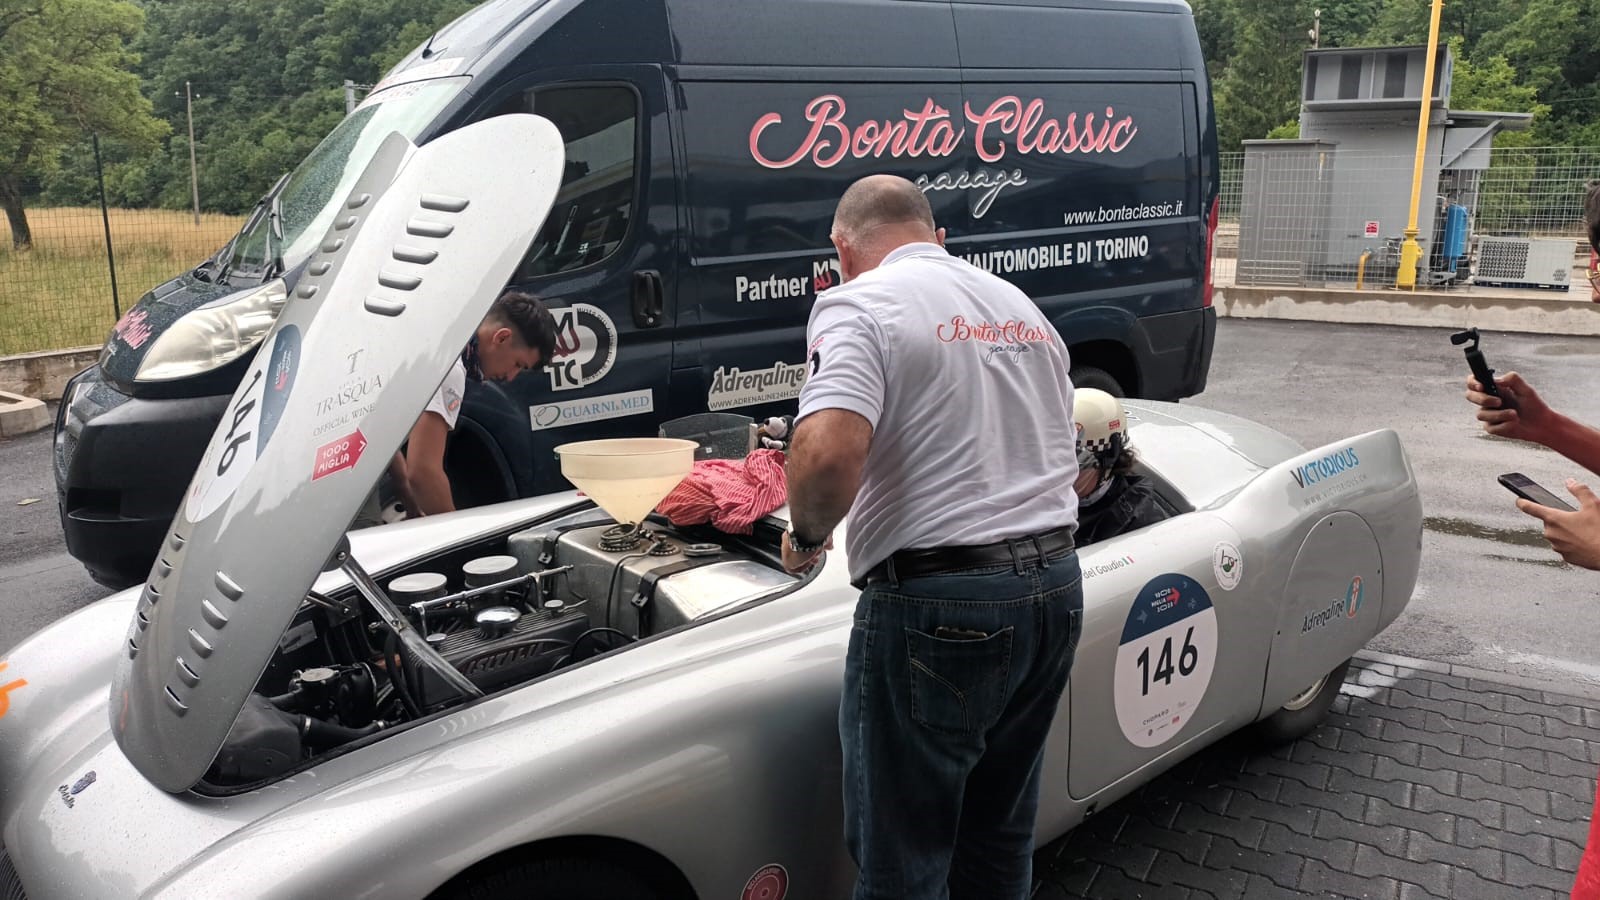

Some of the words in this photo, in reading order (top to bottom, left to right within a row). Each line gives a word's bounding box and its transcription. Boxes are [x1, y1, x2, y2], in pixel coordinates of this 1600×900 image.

[965, 96, 1138, 163] Classic
[1064, 200, 1183, 225] www.bontaclassic.it
[1077, 240, 1091, 264] DI
[1096, 235, 1149, 262] TORINO
[735, 274, 809, 302] Partner
[711, 364, 805, 394] Adrenaline
[315, 374, 382, 417] TRASQUA
[710, 389, 802, 409] WWW.ADRENALINE24H.CO
[216, 369, 262, 477] 146
[313, 415, 351, 437] OFFICIAL
[351, 403, 377, 422] WINE
[318, 453, 350, 474] MIGLIA
[323, 440, 350, 460] 1000
[1290, 447, 1359, 489] VICTORIOUS
[1083, 566, 1096, 579] del
[1096, 559, 1125, 577] Gaudio
[1301, 600, 1345, 634] Adrenaline
[1137, 626, 1198, 697] 146
